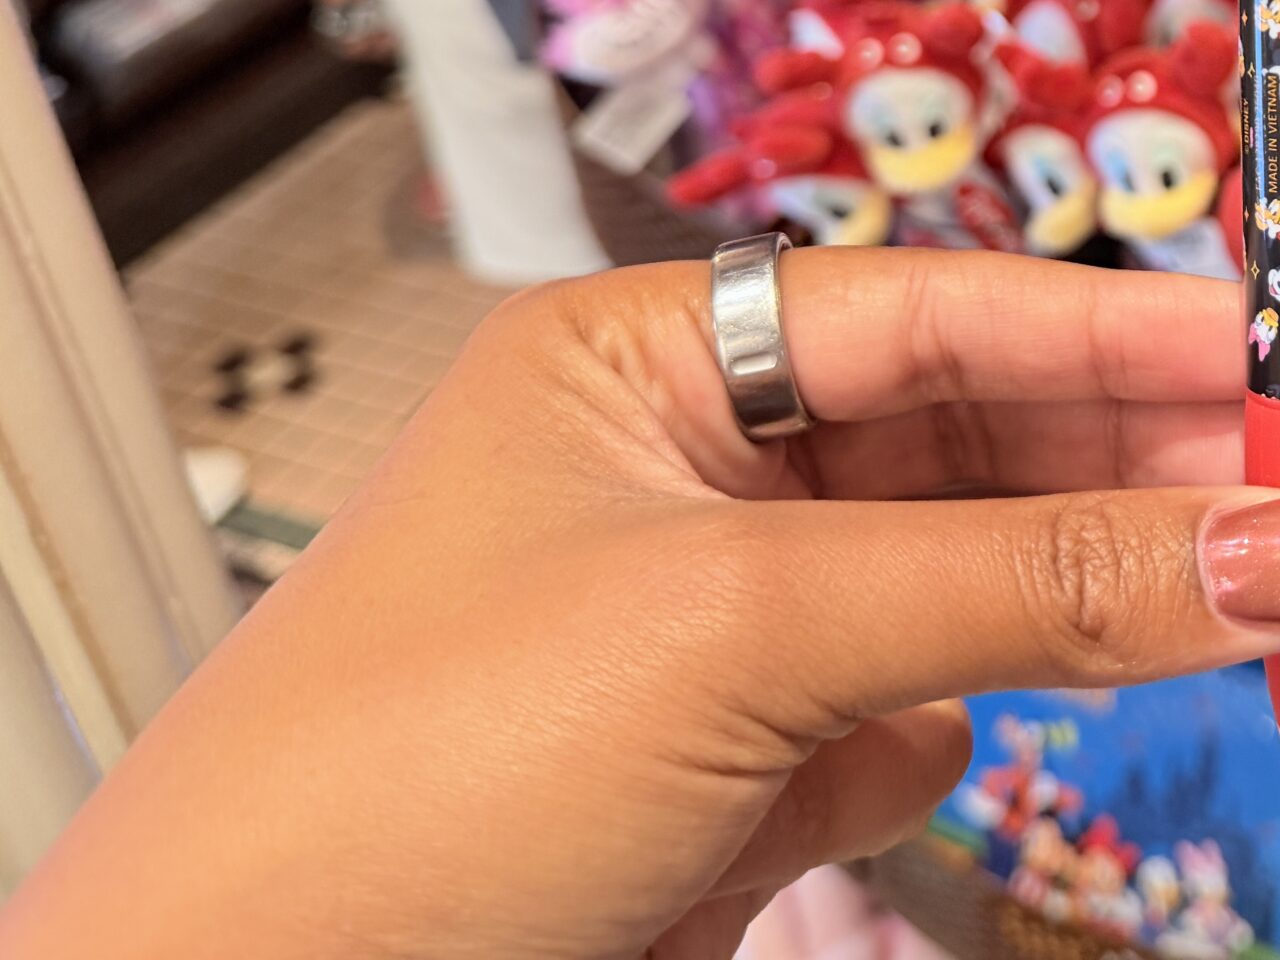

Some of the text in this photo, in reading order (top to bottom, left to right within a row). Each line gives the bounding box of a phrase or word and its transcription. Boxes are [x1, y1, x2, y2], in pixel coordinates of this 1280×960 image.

[1267, 75, 1278, 193] MADE IN VIETNAM
